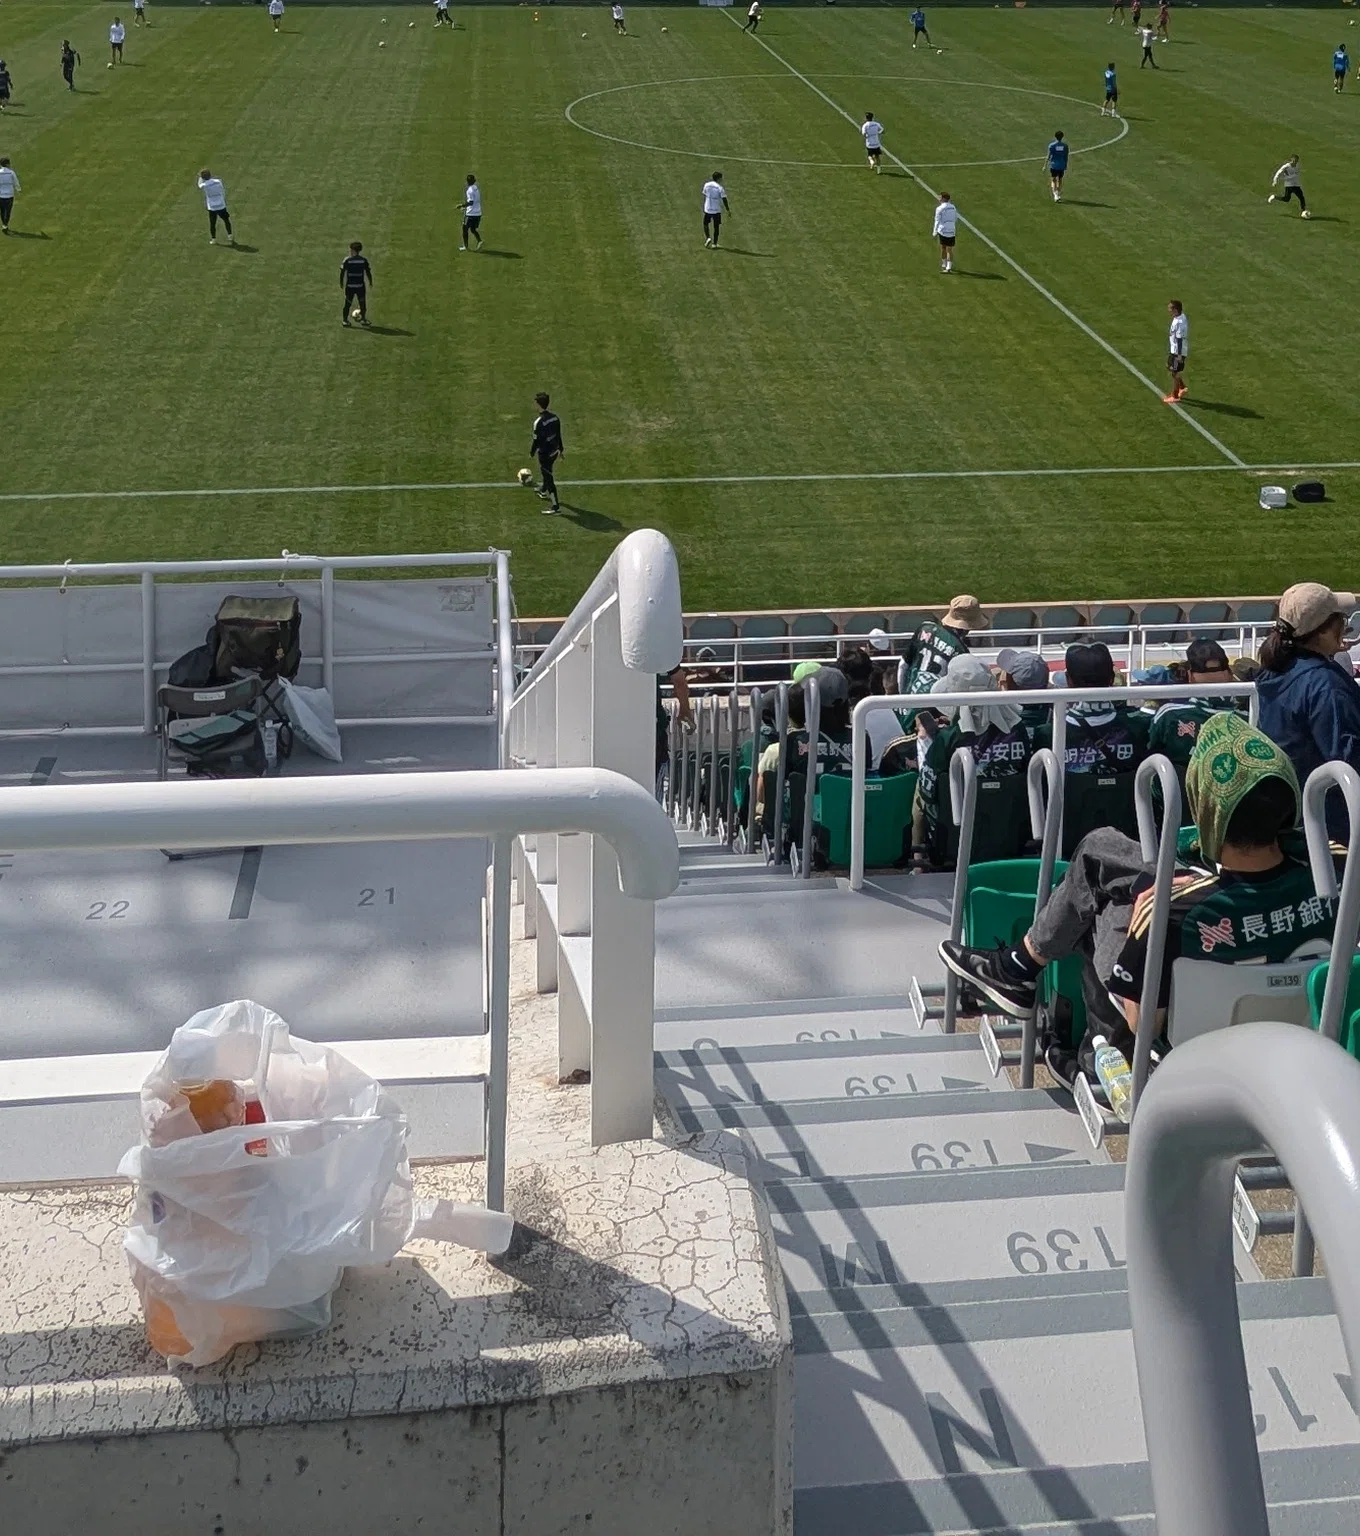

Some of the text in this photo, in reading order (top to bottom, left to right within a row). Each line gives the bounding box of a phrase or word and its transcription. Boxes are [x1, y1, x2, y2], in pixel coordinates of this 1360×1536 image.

[358, 886, 398, 907] 21
[85, 900, 131, 921] 22
[1005, 1225, 1128, 1275] 139
